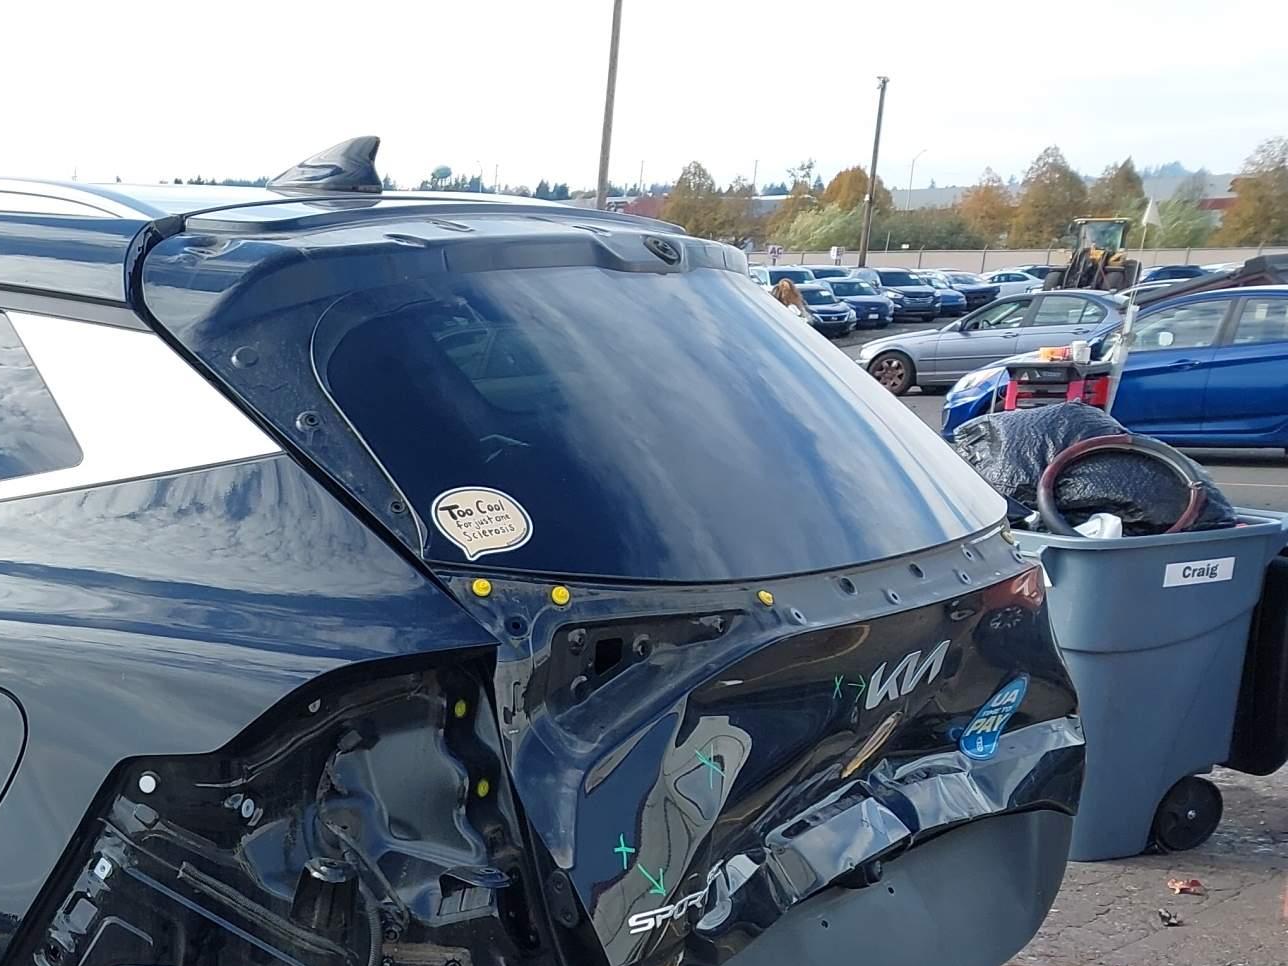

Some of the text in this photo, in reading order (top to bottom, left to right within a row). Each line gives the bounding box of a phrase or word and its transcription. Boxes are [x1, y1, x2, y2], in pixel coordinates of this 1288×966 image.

[439, 499, 505, 521] Too Cool
[475, 516, 494, 530] just
[496, 513, 511, 523] one
[462, 523, 516, 542] Sclerosis
[1182, 563, 1219, 579] Craig
[965, 713, 1012, 737] PAY
